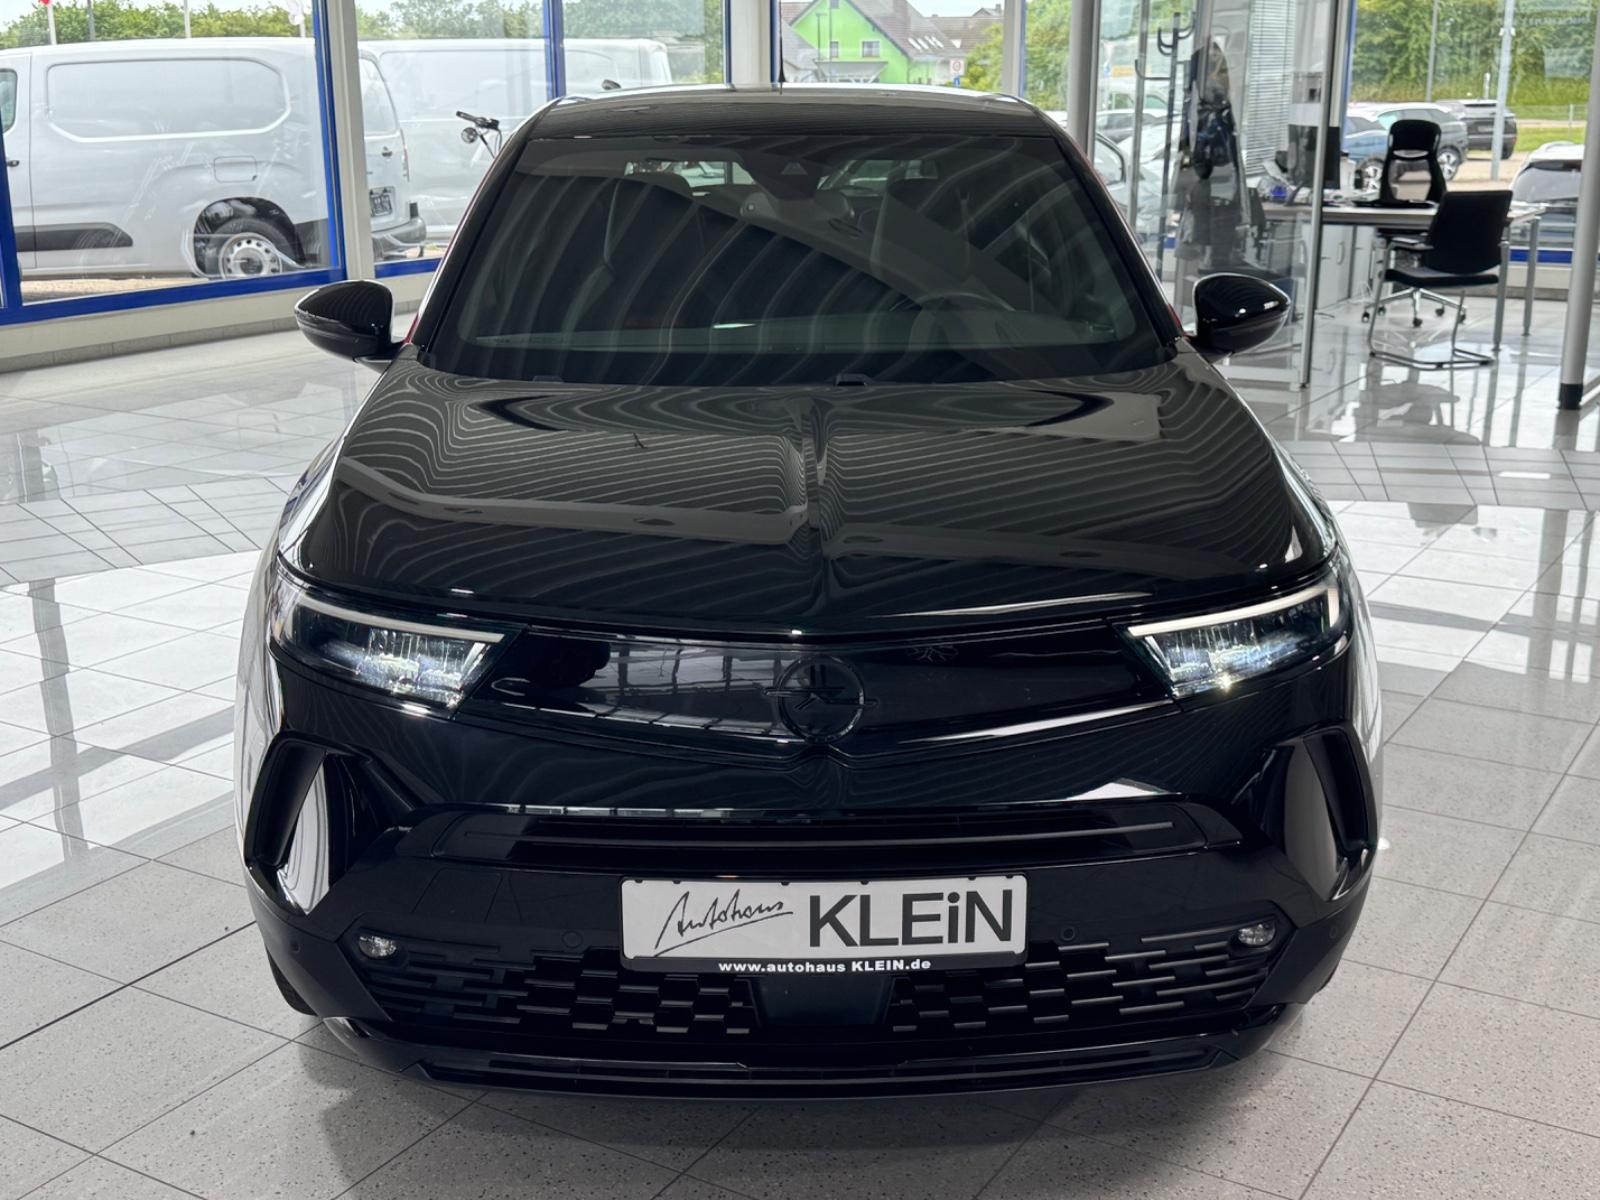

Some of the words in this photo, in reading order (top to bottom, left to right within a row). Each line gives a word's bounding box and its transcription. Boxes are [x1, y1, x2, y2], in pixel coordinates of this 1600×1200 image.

[808, 888, 1013, 948] KLEiN
[718, 961, 846, 973] www.autohaus
[851, 958, 932, 972] KLEIN.de
